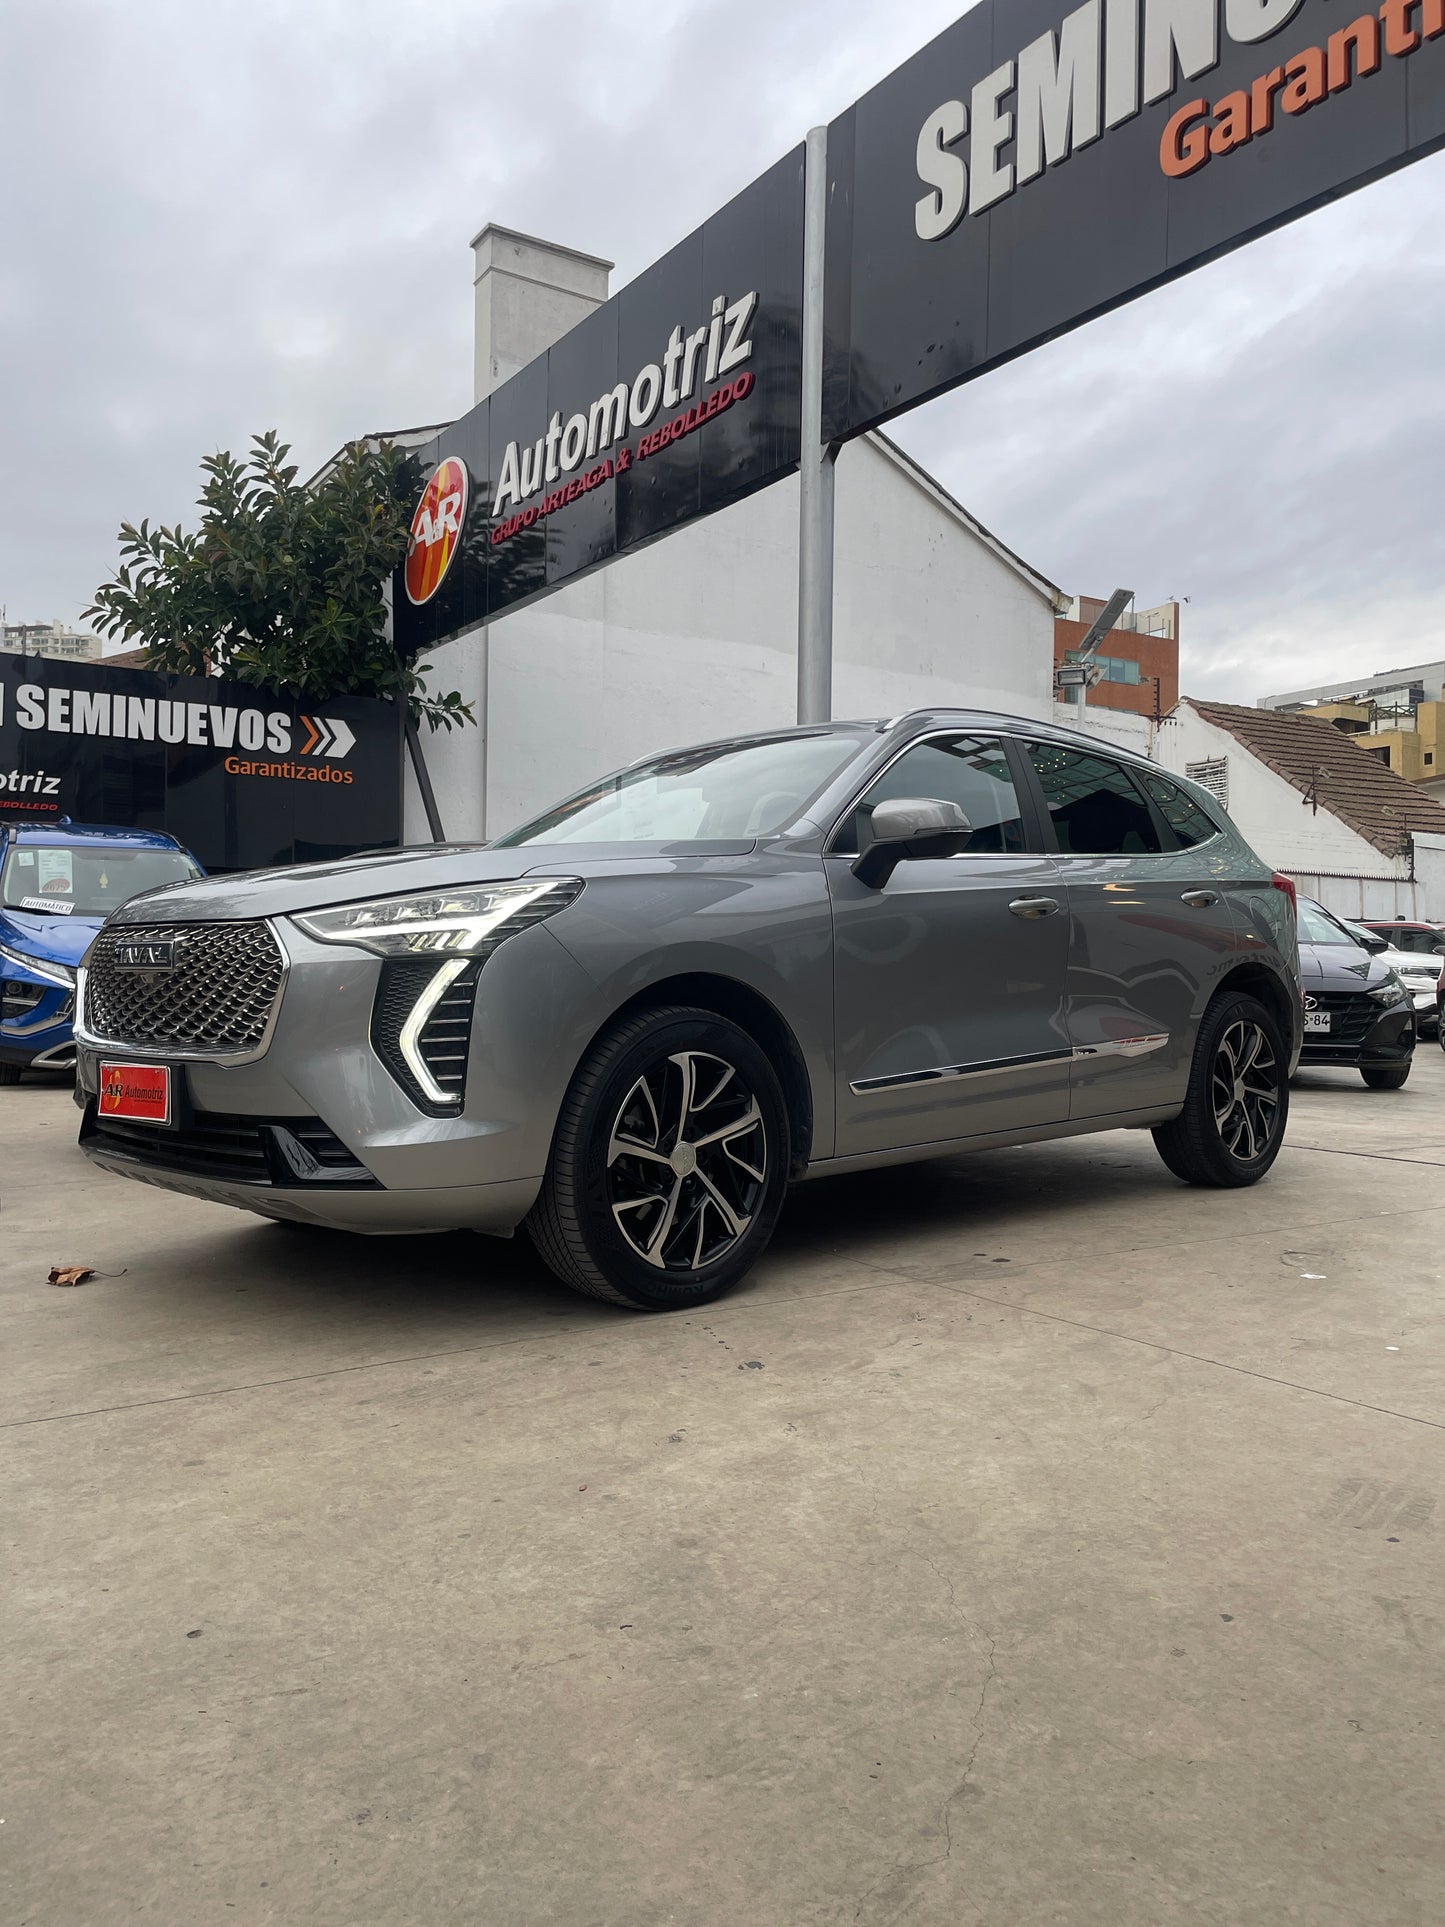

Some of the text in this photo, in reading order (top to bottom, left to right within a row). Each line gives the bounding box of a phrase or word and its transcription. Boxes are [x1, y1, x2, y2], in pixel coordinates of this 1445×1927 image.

[914, 0, 1303, 241] SEMIN
[491, 291, 759, 517] Automotriz
[491, 371, 756, 544] GRUPO ARTEAGA & REBOLLEDO
[16, 684, 292, 754] SEMINUEVOS
[225, 756, 354, 784] Garantizados
[125, 1085, 164, 1100] Automotriz
